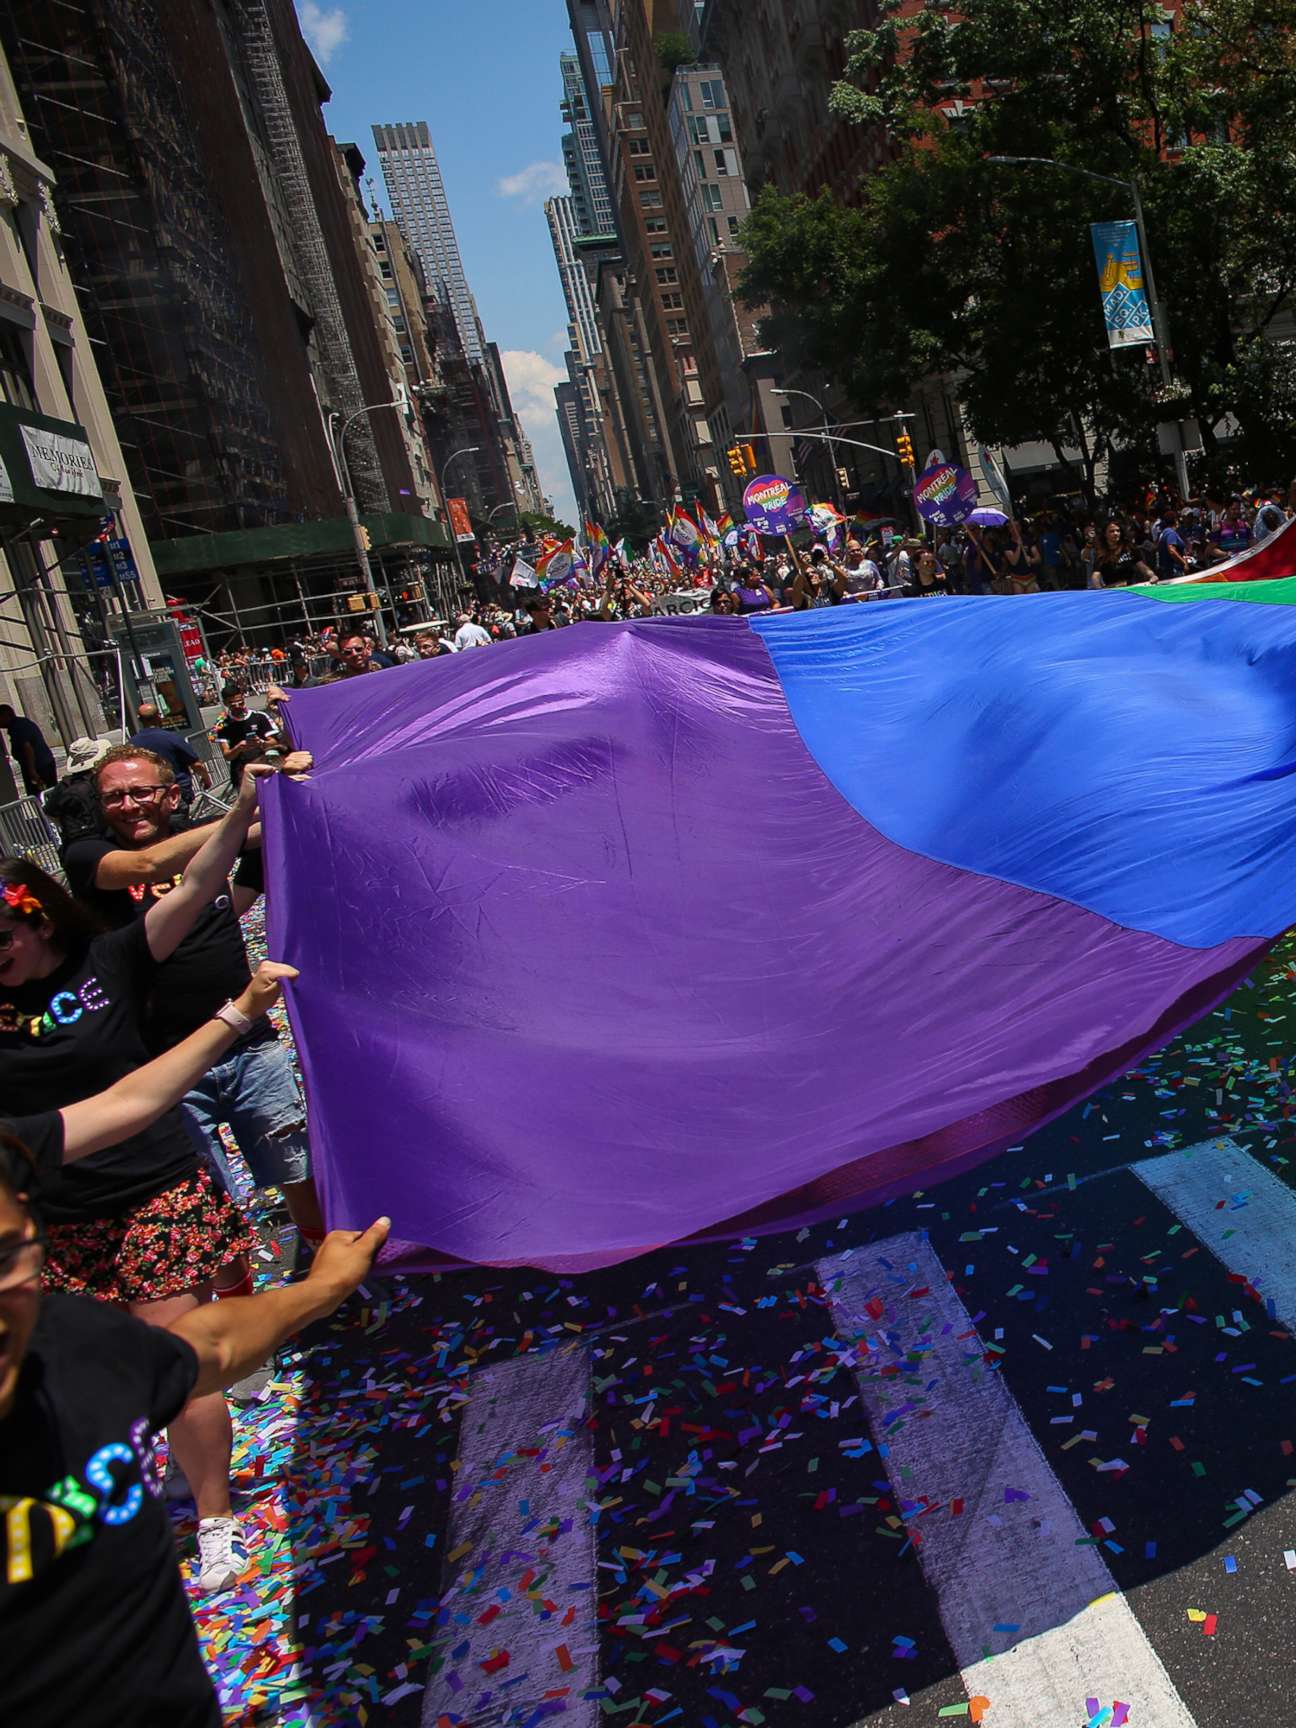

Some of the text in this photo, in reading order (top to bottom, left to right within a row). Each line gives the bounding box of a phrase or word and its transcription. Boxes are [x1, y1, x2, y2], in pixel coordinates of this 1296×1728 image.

[1105, 290, 1127, 316] MAD.
[1114, 307, 1132, 325] SQ.
[1132, 306, 1150, 326] PK.
[32, 445, 94, 471] MEMORIES
[762, 495, 788, 513] PRIDE
[933, 484, 957, 506] PRIDE
